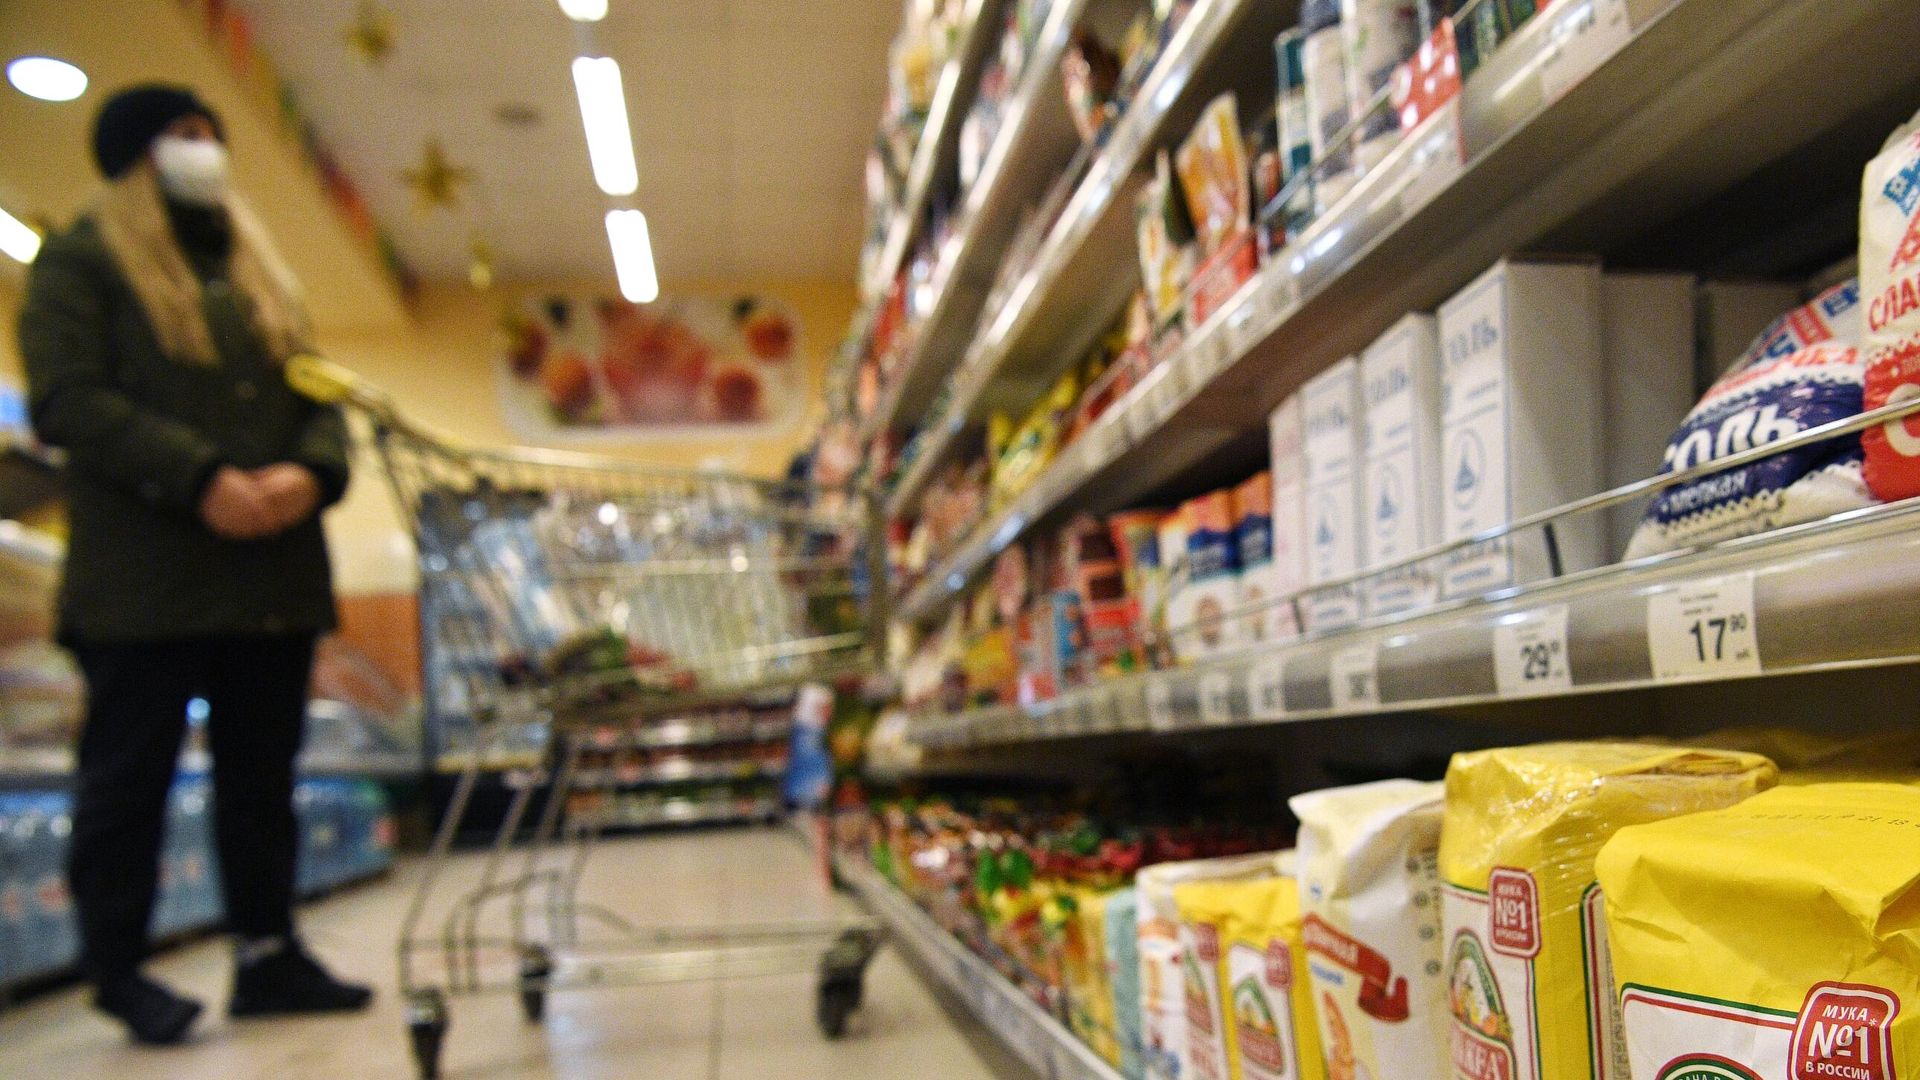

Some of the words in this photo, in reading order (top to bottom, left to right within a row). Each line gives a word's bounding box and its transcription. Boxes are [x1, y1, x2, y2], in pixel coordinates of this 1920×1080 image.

[1868, 262, 1920, 332] СЛА
[1690, 618, 1726, 662] 17
[1806, 1061, 1815, 1073] В
[1817, 1062, 1870, 1080] РОССИИ
